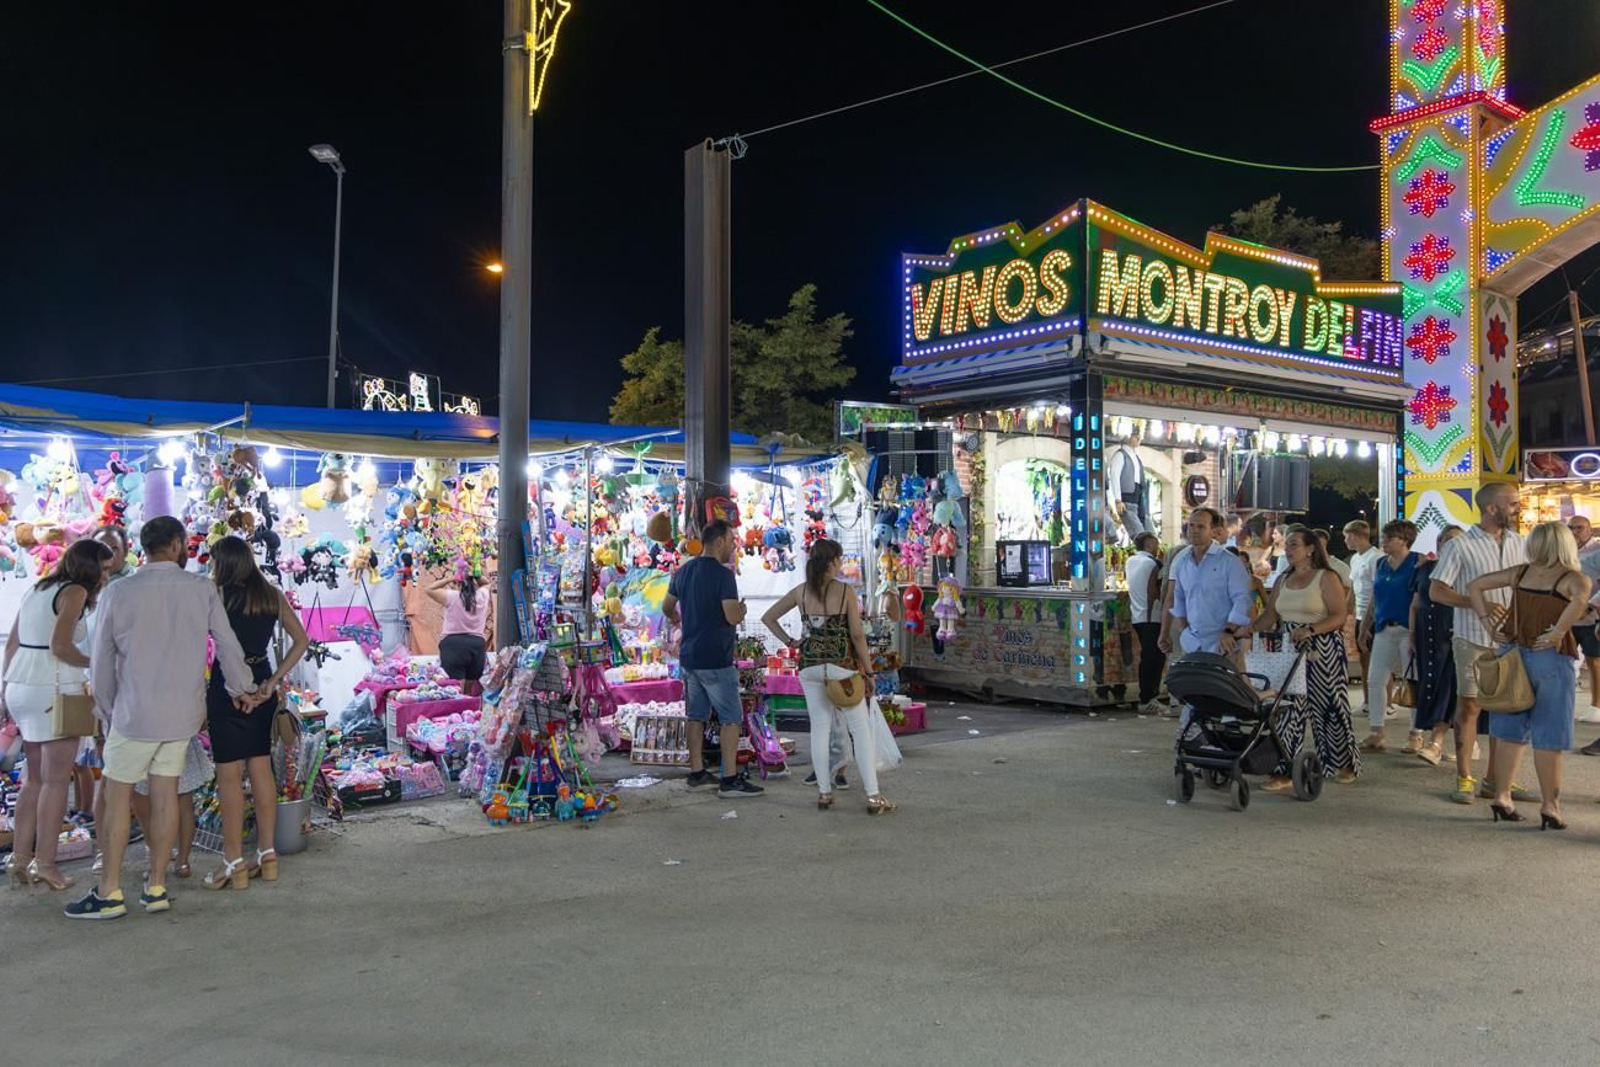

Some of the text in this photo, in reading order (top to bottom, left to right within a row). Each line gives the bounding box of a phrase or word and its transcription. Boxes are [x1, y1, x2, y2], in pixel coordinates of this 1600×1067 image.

[911, 249, 1072, 341] VINOS
[1097, 248, 1403, 368] MONTROY DELFIN
[1075, 438, 1086, 552] DELFIN
[1092, 437, 1101, 552] DELFIN
